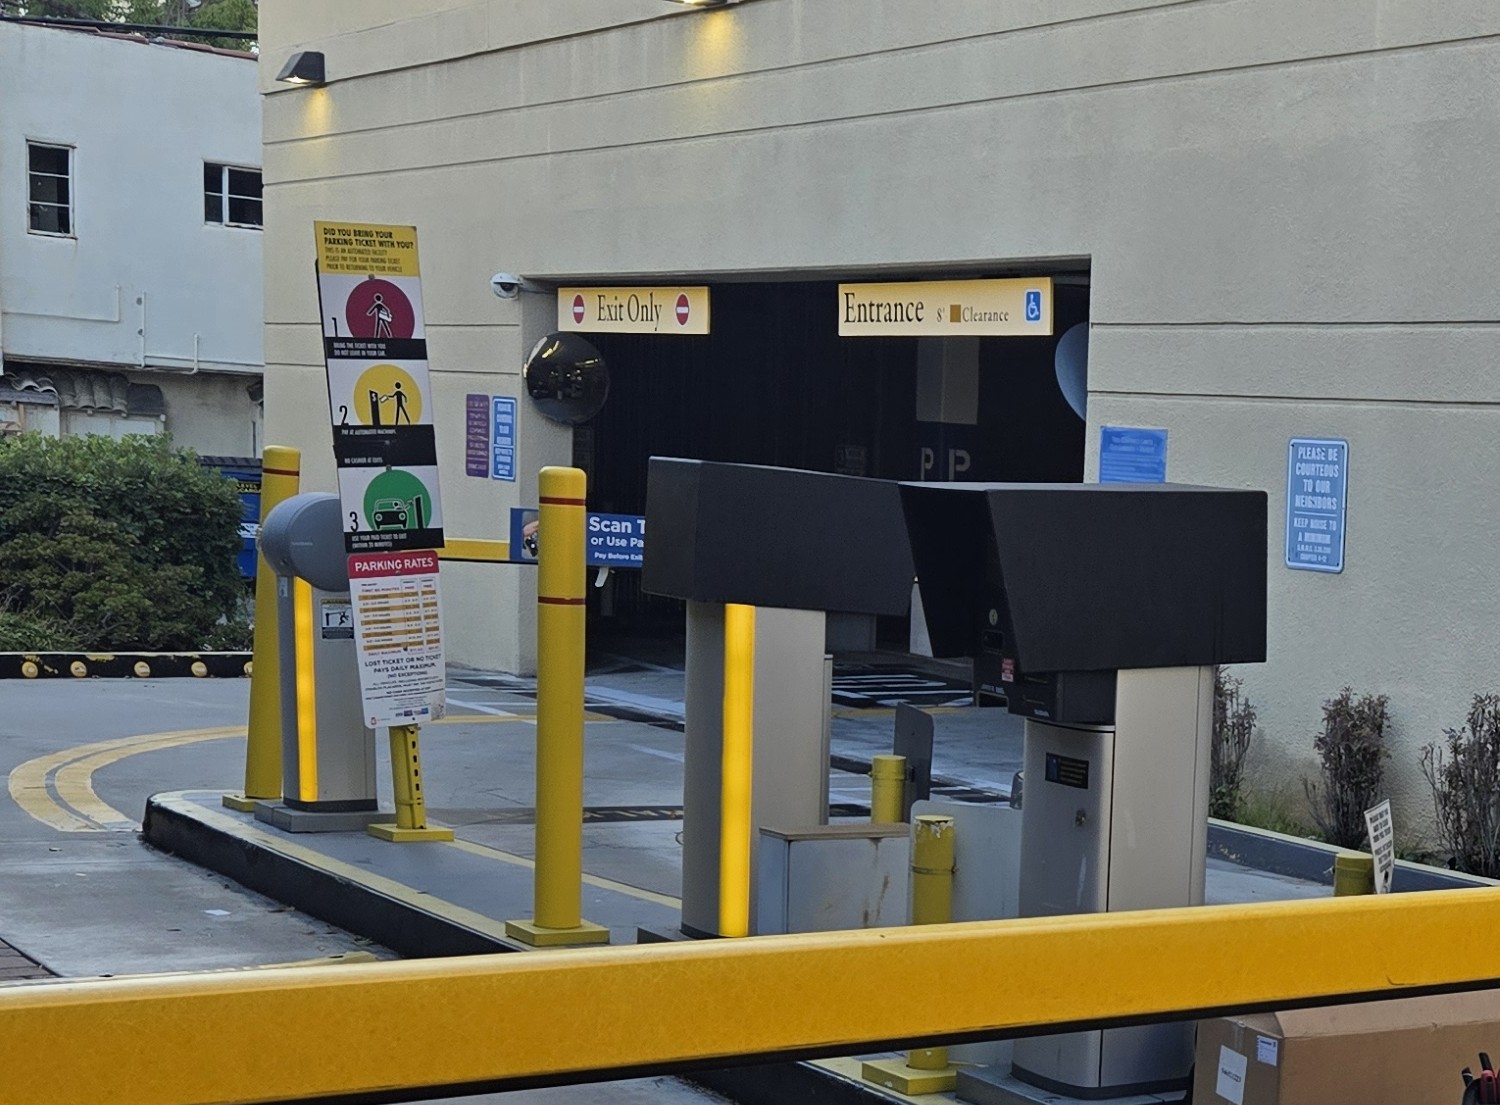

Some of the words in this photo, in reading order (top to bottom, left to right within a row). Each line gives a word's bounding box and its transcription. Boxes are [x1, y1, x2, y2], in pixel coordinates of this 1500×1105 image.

[353, 229, 374, 238] BRING
[375, 230, 392, 239] YOUR
[324, 237, 353, 246] PARKING
[355, 239, 376, 247] TICKET
[378, 240, 395, 248] WITH
[396, 241, 414, 249] YOU?
[597, 294, 624, 321] Exit
[627, 292, 662, 332] Only
[844, 292, 924, 323] Entrance
[962, 307, 1009, 322] Clearance
[339, 405, 349, 426] 2
[1298, 447, 1326, 460] PLEASE
[1328, 448, 1338, 461] BE
[1295, 462, 1339, 477] COURTEOUS
[1303, 479, 1313, 492] TO
[1316, 480, 1331, 493] OUR
[1295, 494, 1337, 510] NEIGHBORS
[350, 511, 359, 532] 3
[589, 516, 632, 534] Scan
[1294, 518, 1308, 528] KEEP
[1310, 519, 1327, 530] NOISE
[1329, 520, 1337, 531] TO
[591, 537, 604, 546] or
[606, 536, 628, 547] Use
[1298, 532, 1303, 541] A
[608, 552, 630, 560] Before
[354, 559, 402, 572] PARKING
[404, 557, 434, 569] RATES
